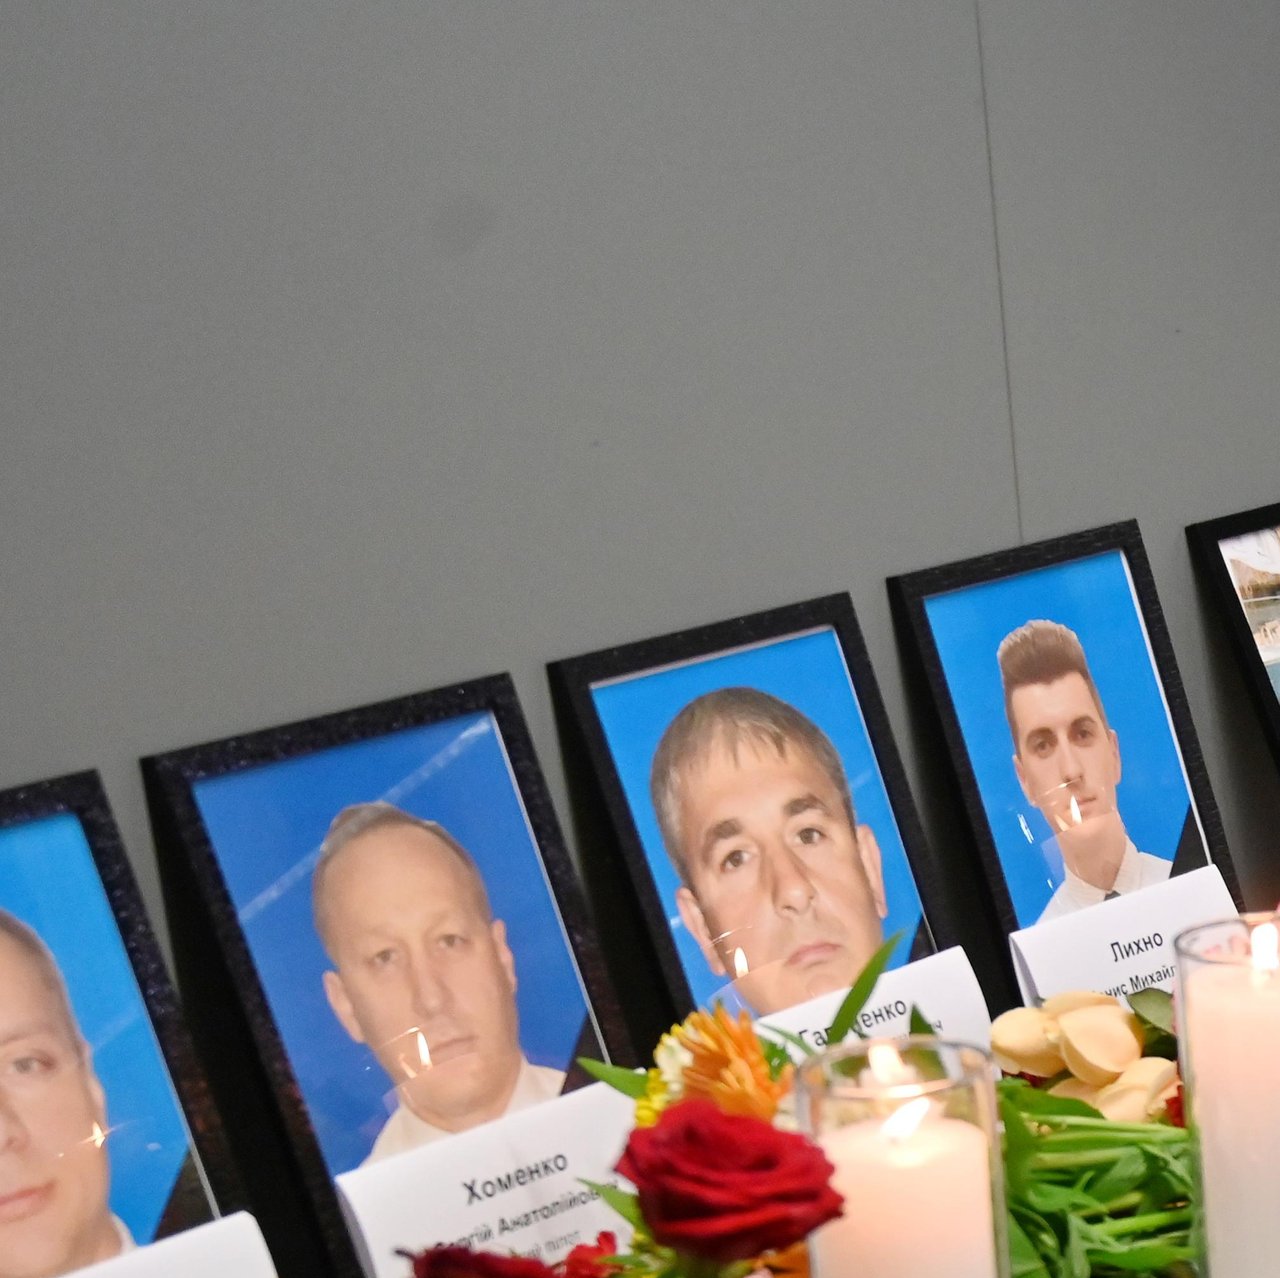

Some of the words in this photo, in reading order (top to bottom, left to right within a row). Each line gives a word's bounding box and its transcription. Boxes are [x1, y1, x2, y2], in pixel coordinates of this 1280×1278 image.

[1110, 932, 1163, 962] Лихно
[463, 1154, 569, 1205] Хоменко
[499, 1180, 618, 1235] Анатолійов
